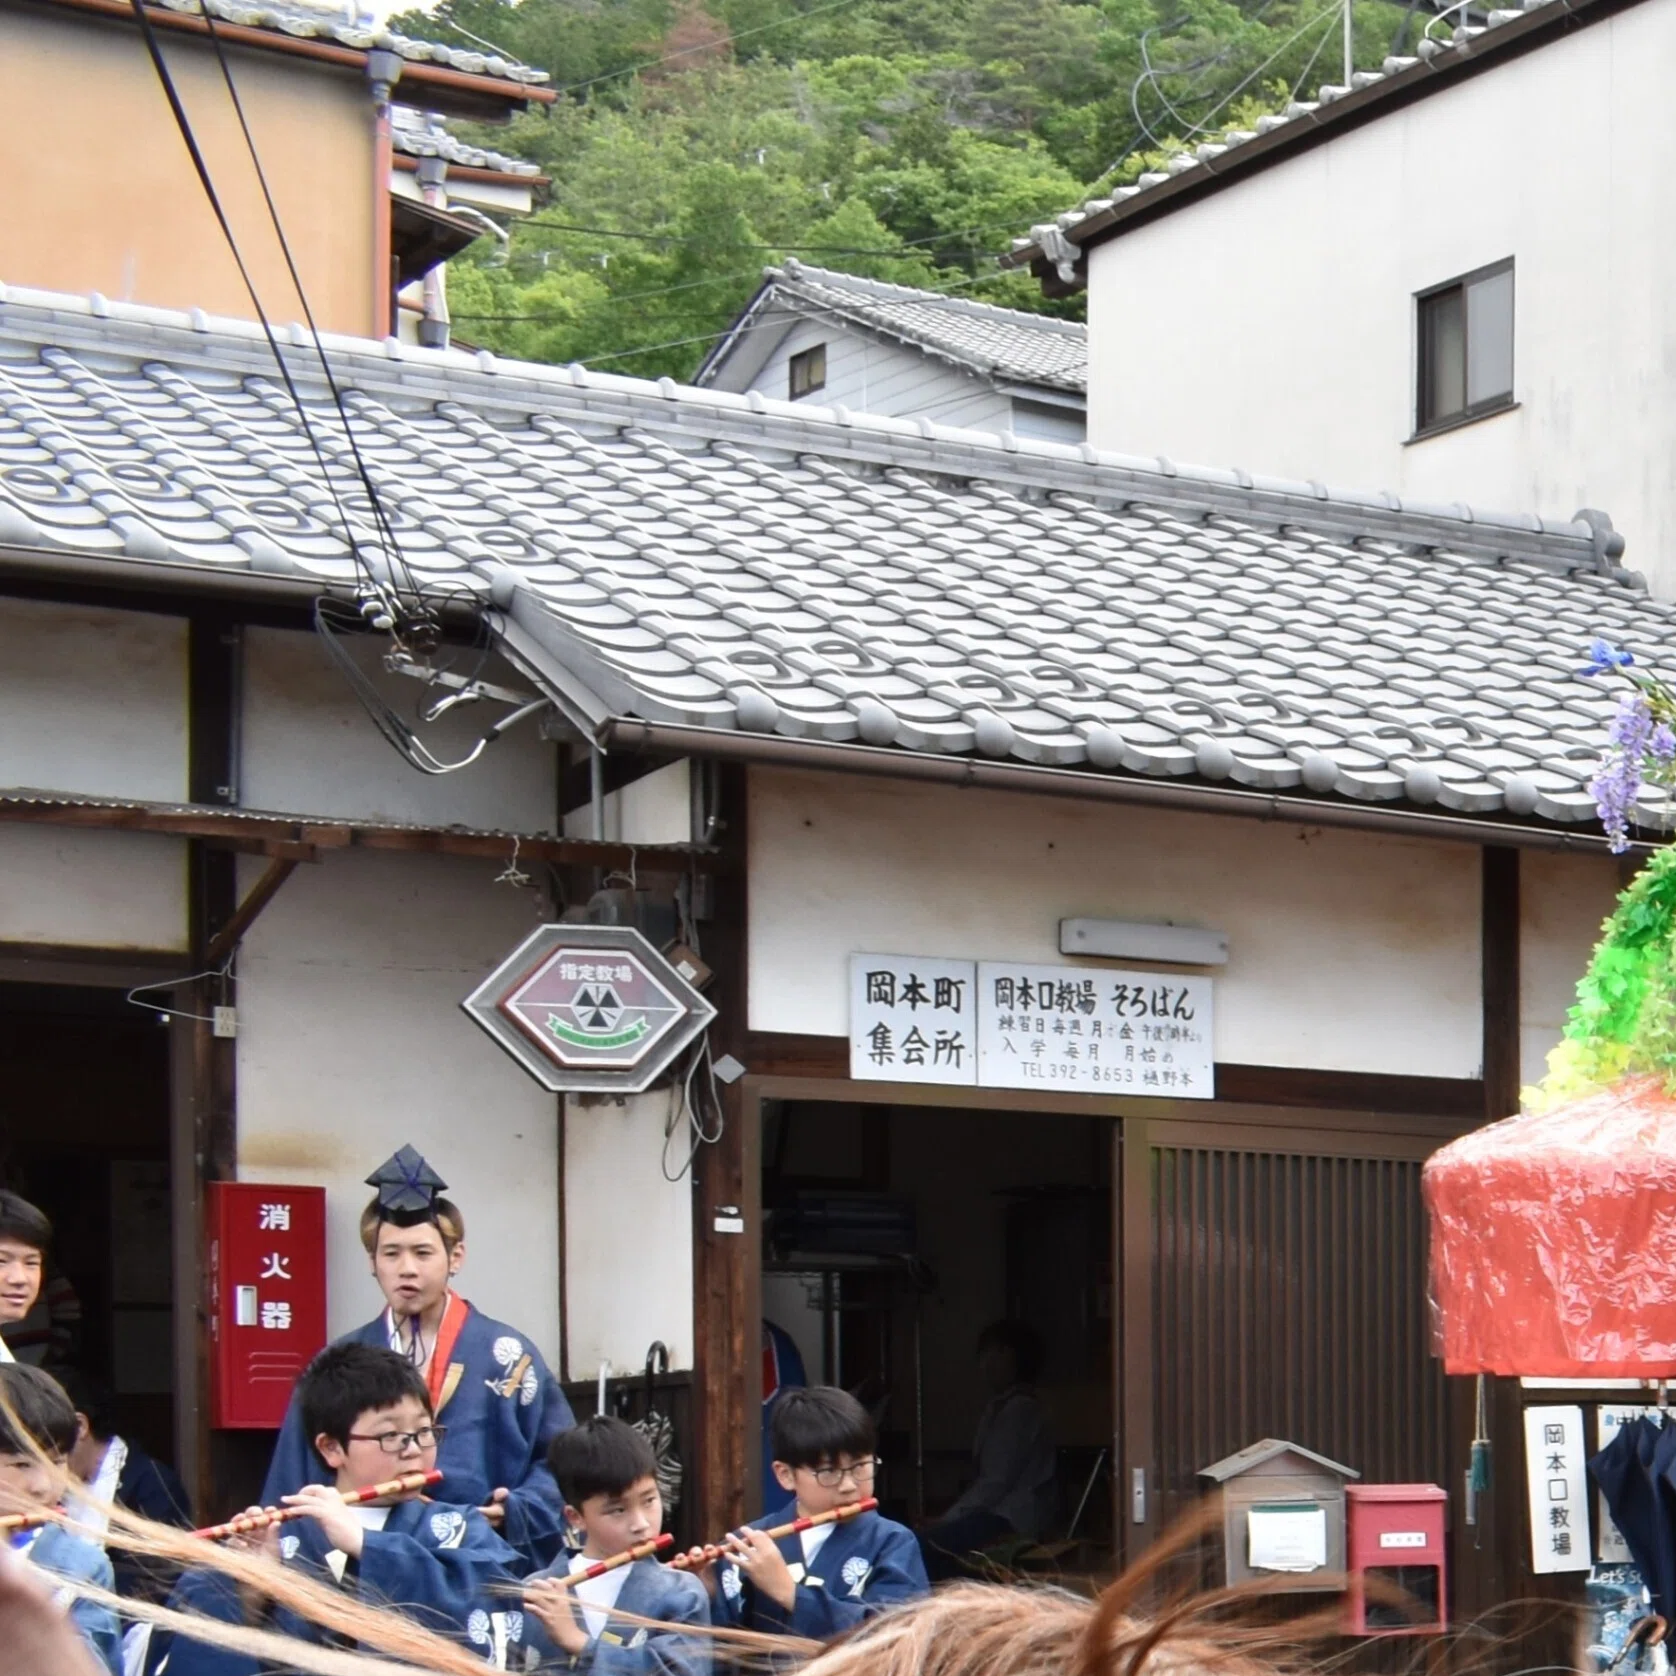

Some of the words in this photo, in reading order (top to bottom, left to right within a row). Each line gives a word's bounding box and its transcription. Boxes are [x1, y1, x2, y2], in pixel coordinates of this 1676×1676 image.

[560, 963, 633, 982] 指定教場
[866, 970, 966, 1014] 岡本町
[994, 976, 1098, 1016] 岡本口教場
[1110, 983, 1195, 1021] そろばん
[866, 1020, 966, 1069] 集会所
[259, 1203, 292, 1329] 消火器
[1543, 1423, 1573, 1556] 岡本口教場
